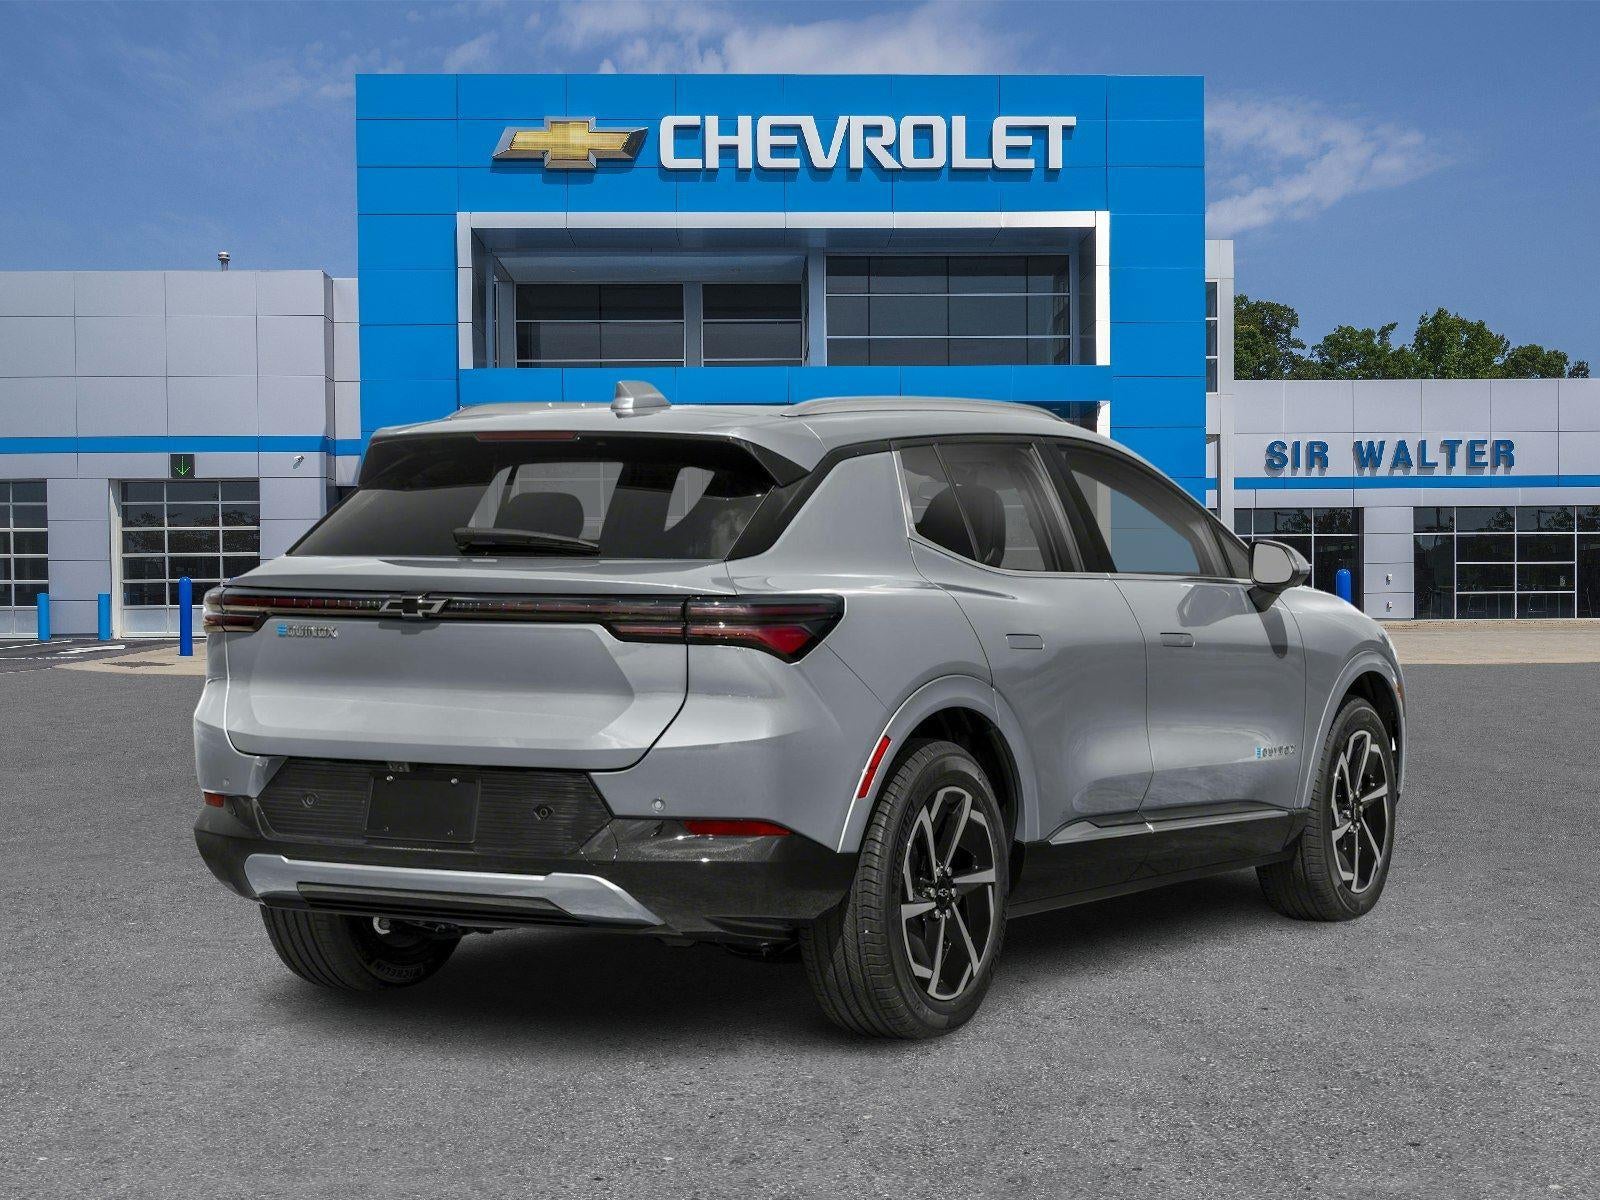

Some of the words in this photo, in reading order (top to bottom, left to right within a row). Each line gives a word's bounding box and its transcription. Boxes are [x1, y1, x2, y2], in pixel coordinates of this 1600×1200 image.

[659, 115, 1077, 170] CHEVROLET
[1265, 440, 1329, 469] SIR
[1353, 439, 1515, 468] WALTER
